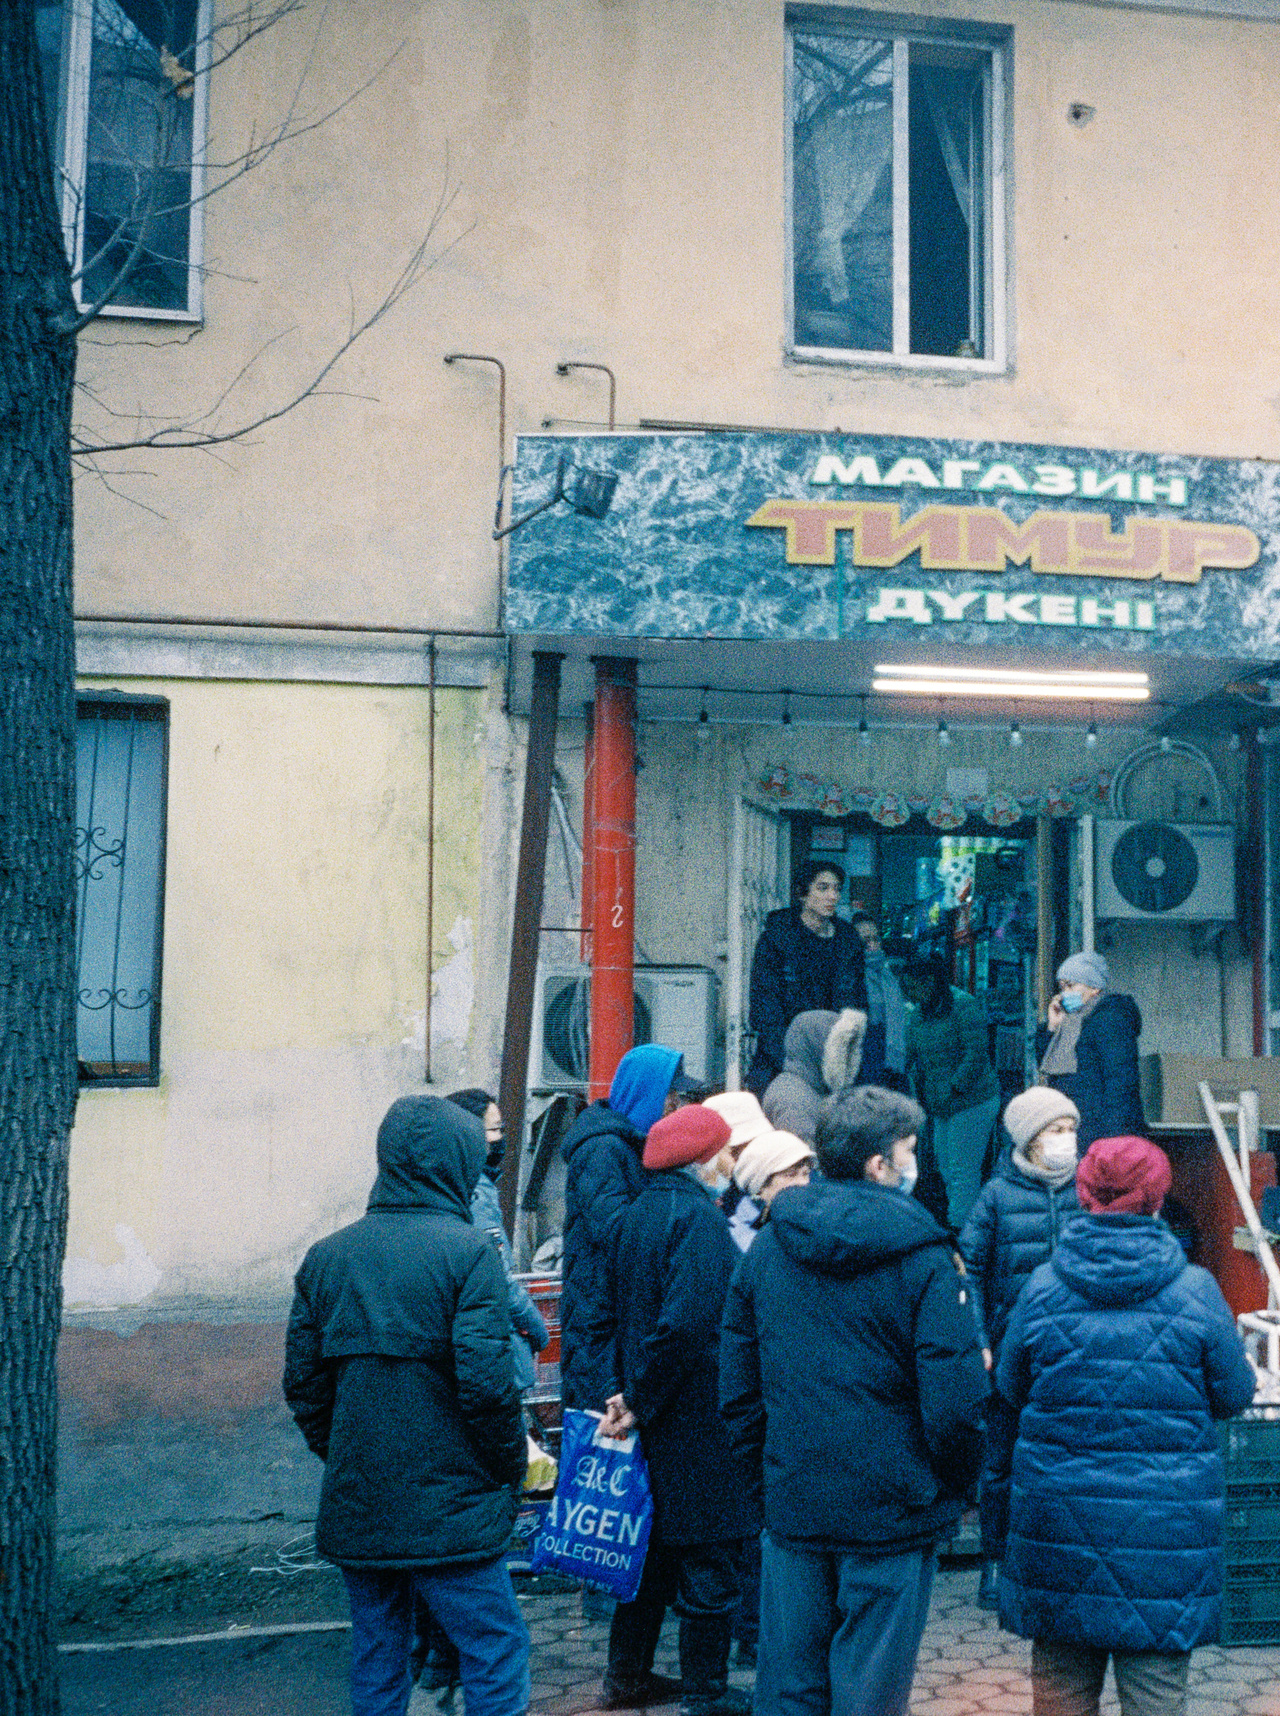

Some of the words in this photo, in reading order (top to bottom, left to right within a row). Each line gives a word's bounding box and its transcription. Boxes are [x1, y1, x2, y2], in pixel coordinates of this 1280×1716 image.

[811, 454, 1188, 505] МАГАЗИН
[745, 499, 1260, 583] ТИМУР
[866, 589, 1156, 630] ДҮКЕНІ
